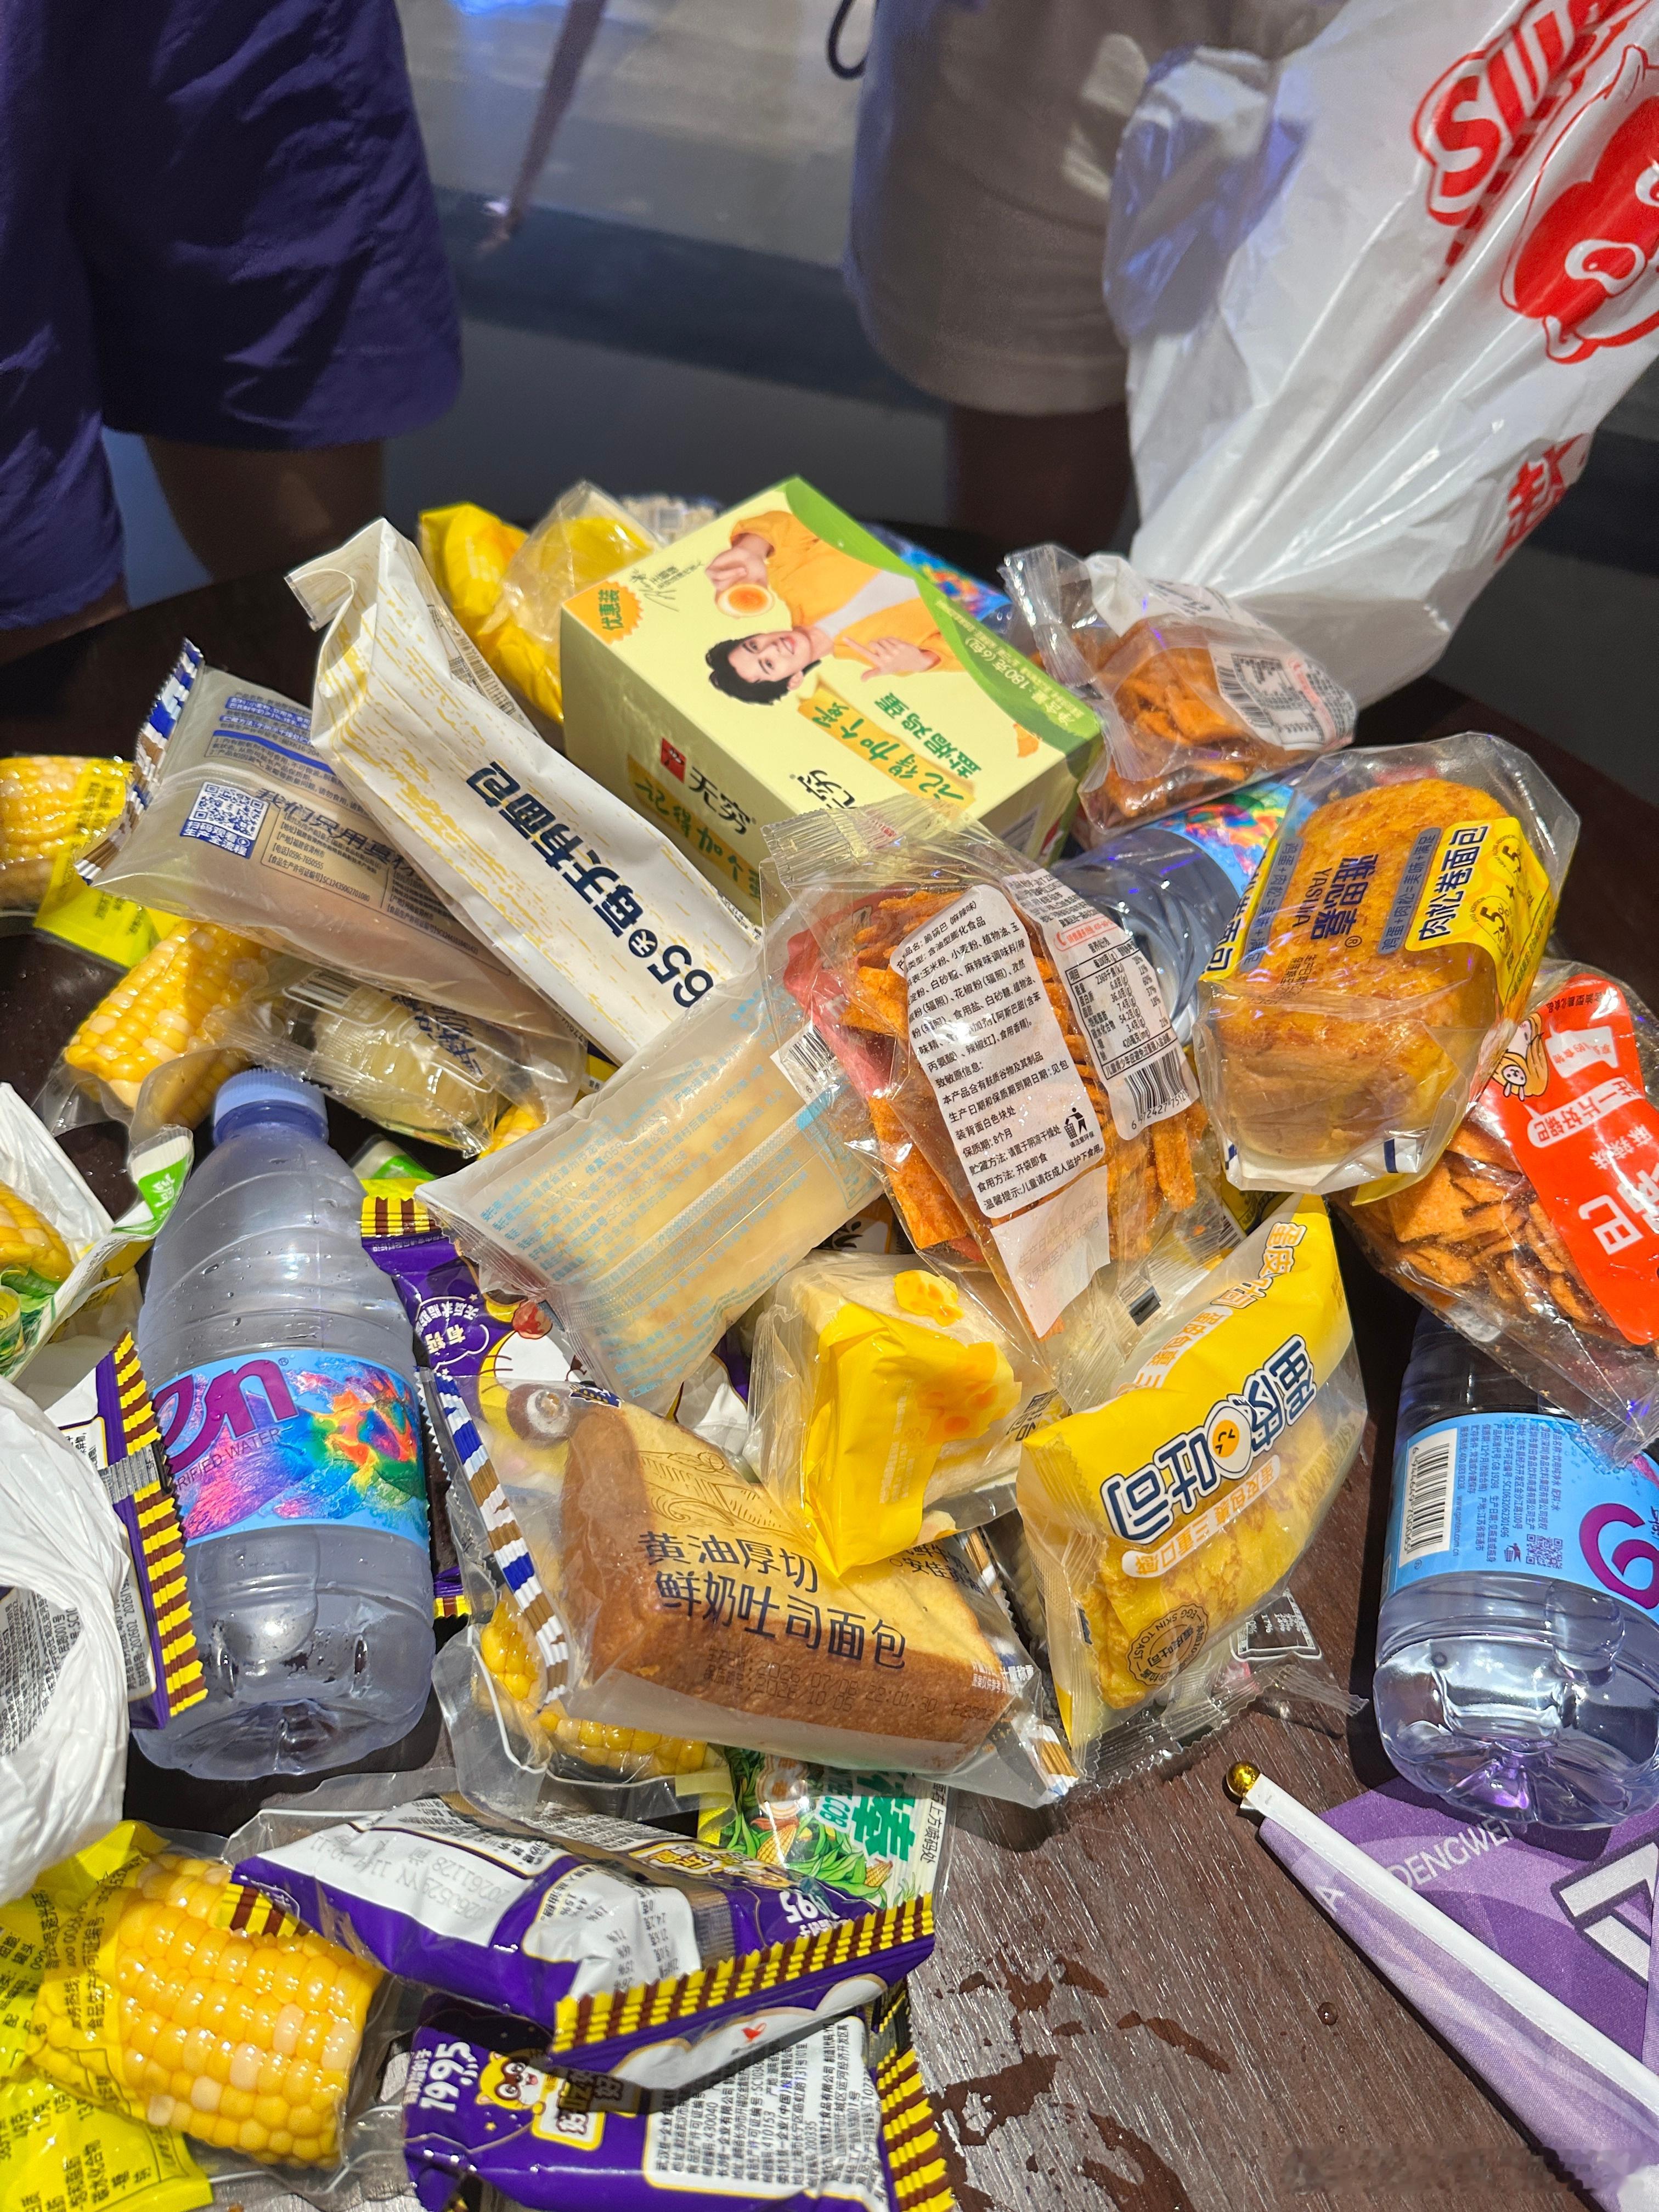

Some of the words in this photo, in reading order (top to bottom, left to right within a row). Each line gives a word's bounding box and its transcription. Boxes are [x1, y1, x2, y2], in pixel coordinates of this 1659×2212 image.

[601, 589, 625, 632] 优惠装
[874, 690, 982, 780] 盐焗鸡蛋
[689, 765, 754, 836] 无穷
[183, 827, 247, 856] 生产全流程
[188, 821, 238, 843] 扫码观看
[1310, 854, 1378, 939] 雅思嘉
[1381, 833, 1435, 949] 鸡蛋+肉松=美味+满足
[1417, 827, 1488, 939] 肉松卷面包
[1074, 982, 1086, 995] 能量
[1079, 990, 1094, 1006] 蛋白质
[1091, 1019, 1116, 1039] 碳水化合物
[934, 1060, 984, 1088] 致敏原信息：
[941, 1051, 1043, 1105] 本产品含有麸质谷物及其制品
[948, 1059, 1069, 1123] 生产日期和保质期到期日期：见包
[955, 1105, 1017, 1140] 装背面白色块处
[1069, 1131, 1094, 1148] 请注意环保
[1588, 1123, 1652, 1171] 麻辣味
[224, 1427, 282, 1464] WATER
[1104, 1339, 1313, 1537] 蛋皮吐司
[1209, 1460, 1272, 1525] 蛋皮包裹
[1136, 1515, 1210, 1574] 三重口感
[1452, 1495, 1464, 1556] www.ganten.com.cn
[637, 1531, 818, 1594] 黄油厚切
[654, 1570, 907, 1670] 鲜奶吐司面包
[422, 2041, 470, 2111] 1995
